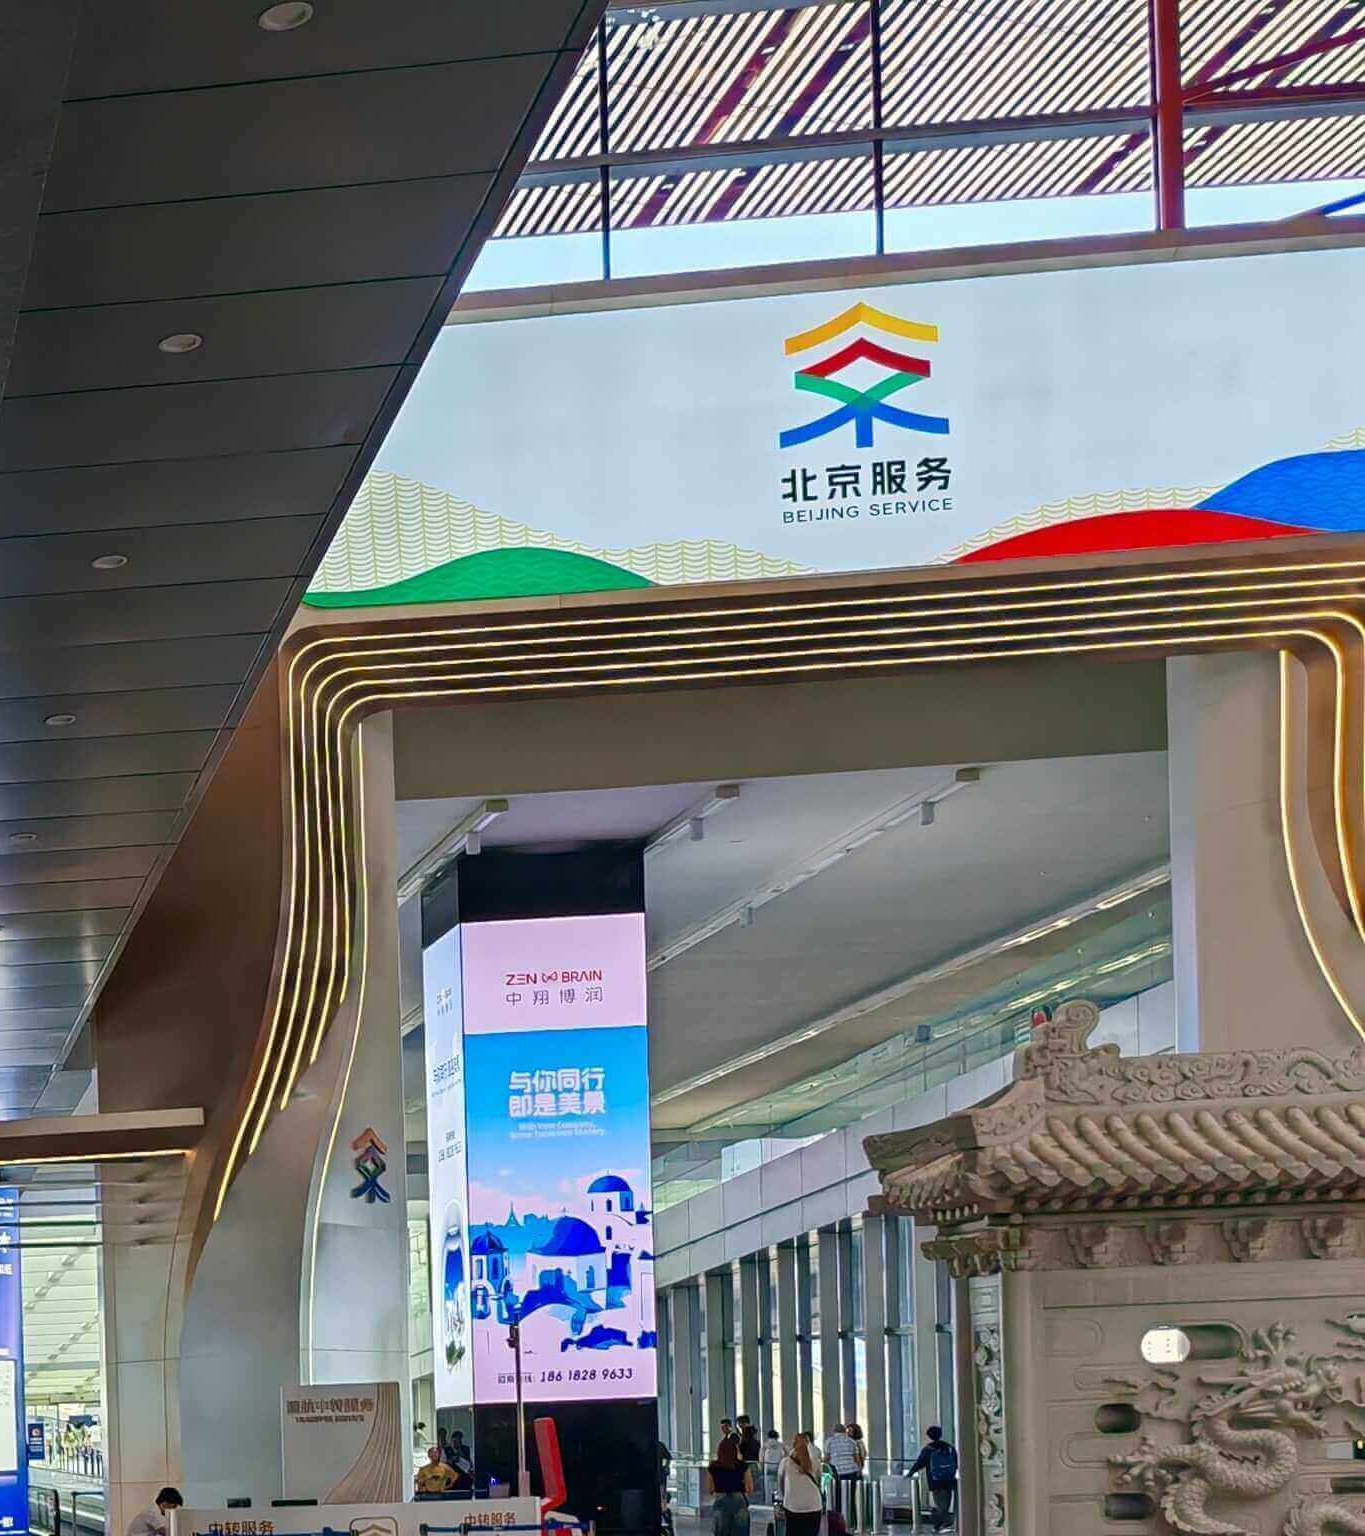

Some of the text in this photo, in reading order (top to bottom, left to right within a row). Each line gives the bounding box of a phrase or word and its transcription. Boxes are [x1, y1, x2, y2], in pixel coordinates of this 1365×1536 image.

[780, 456, 953, 503] 北京服务
[782, 497, 954, 525] BEIJING SERVICE
[505, 969, 603, 986] ZEN BRAIN
[505, 986, 603, 1008] 中翔博润
[509, 1067, 606, 1093] 与你同行
[509, 1091, 606, 1118] 即是美景
[540, 1371, 563, 1383] 186
[567, 1369, 597, 1382] 1828
[601, 1367, 634, 1381] 9633
